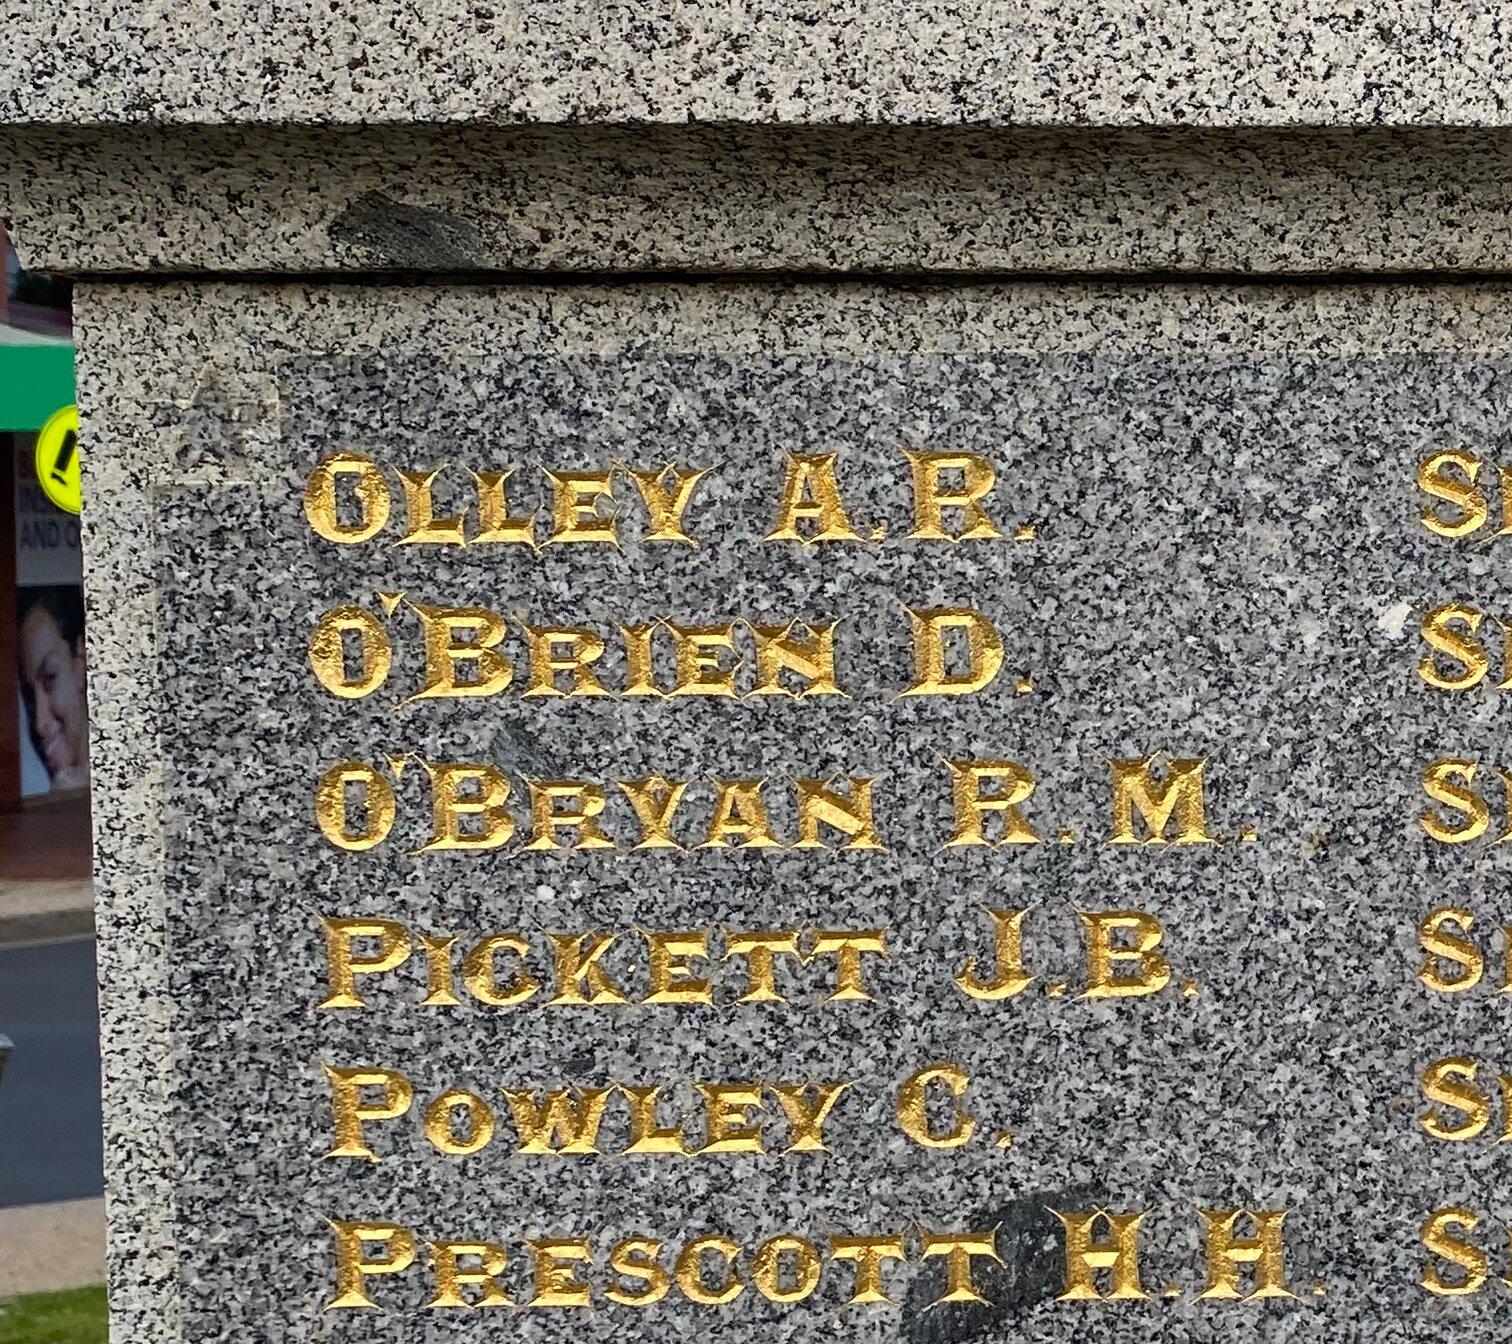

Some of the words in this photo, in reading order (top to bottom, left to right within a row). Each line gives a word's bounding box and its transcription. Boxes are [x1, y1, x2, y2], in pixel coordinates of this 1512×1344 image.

[302, 449, 707, 544] OLLEY
[307, 591, 842, 700] O'BRIEN
[314, 751, 888, 852] O'BRYAN
[317, 912, 888, 1006] PICKETT
[322, 1063, 853, 1158] POWLEY
[324, 1216, 1003, 1308] PRESCOTT
